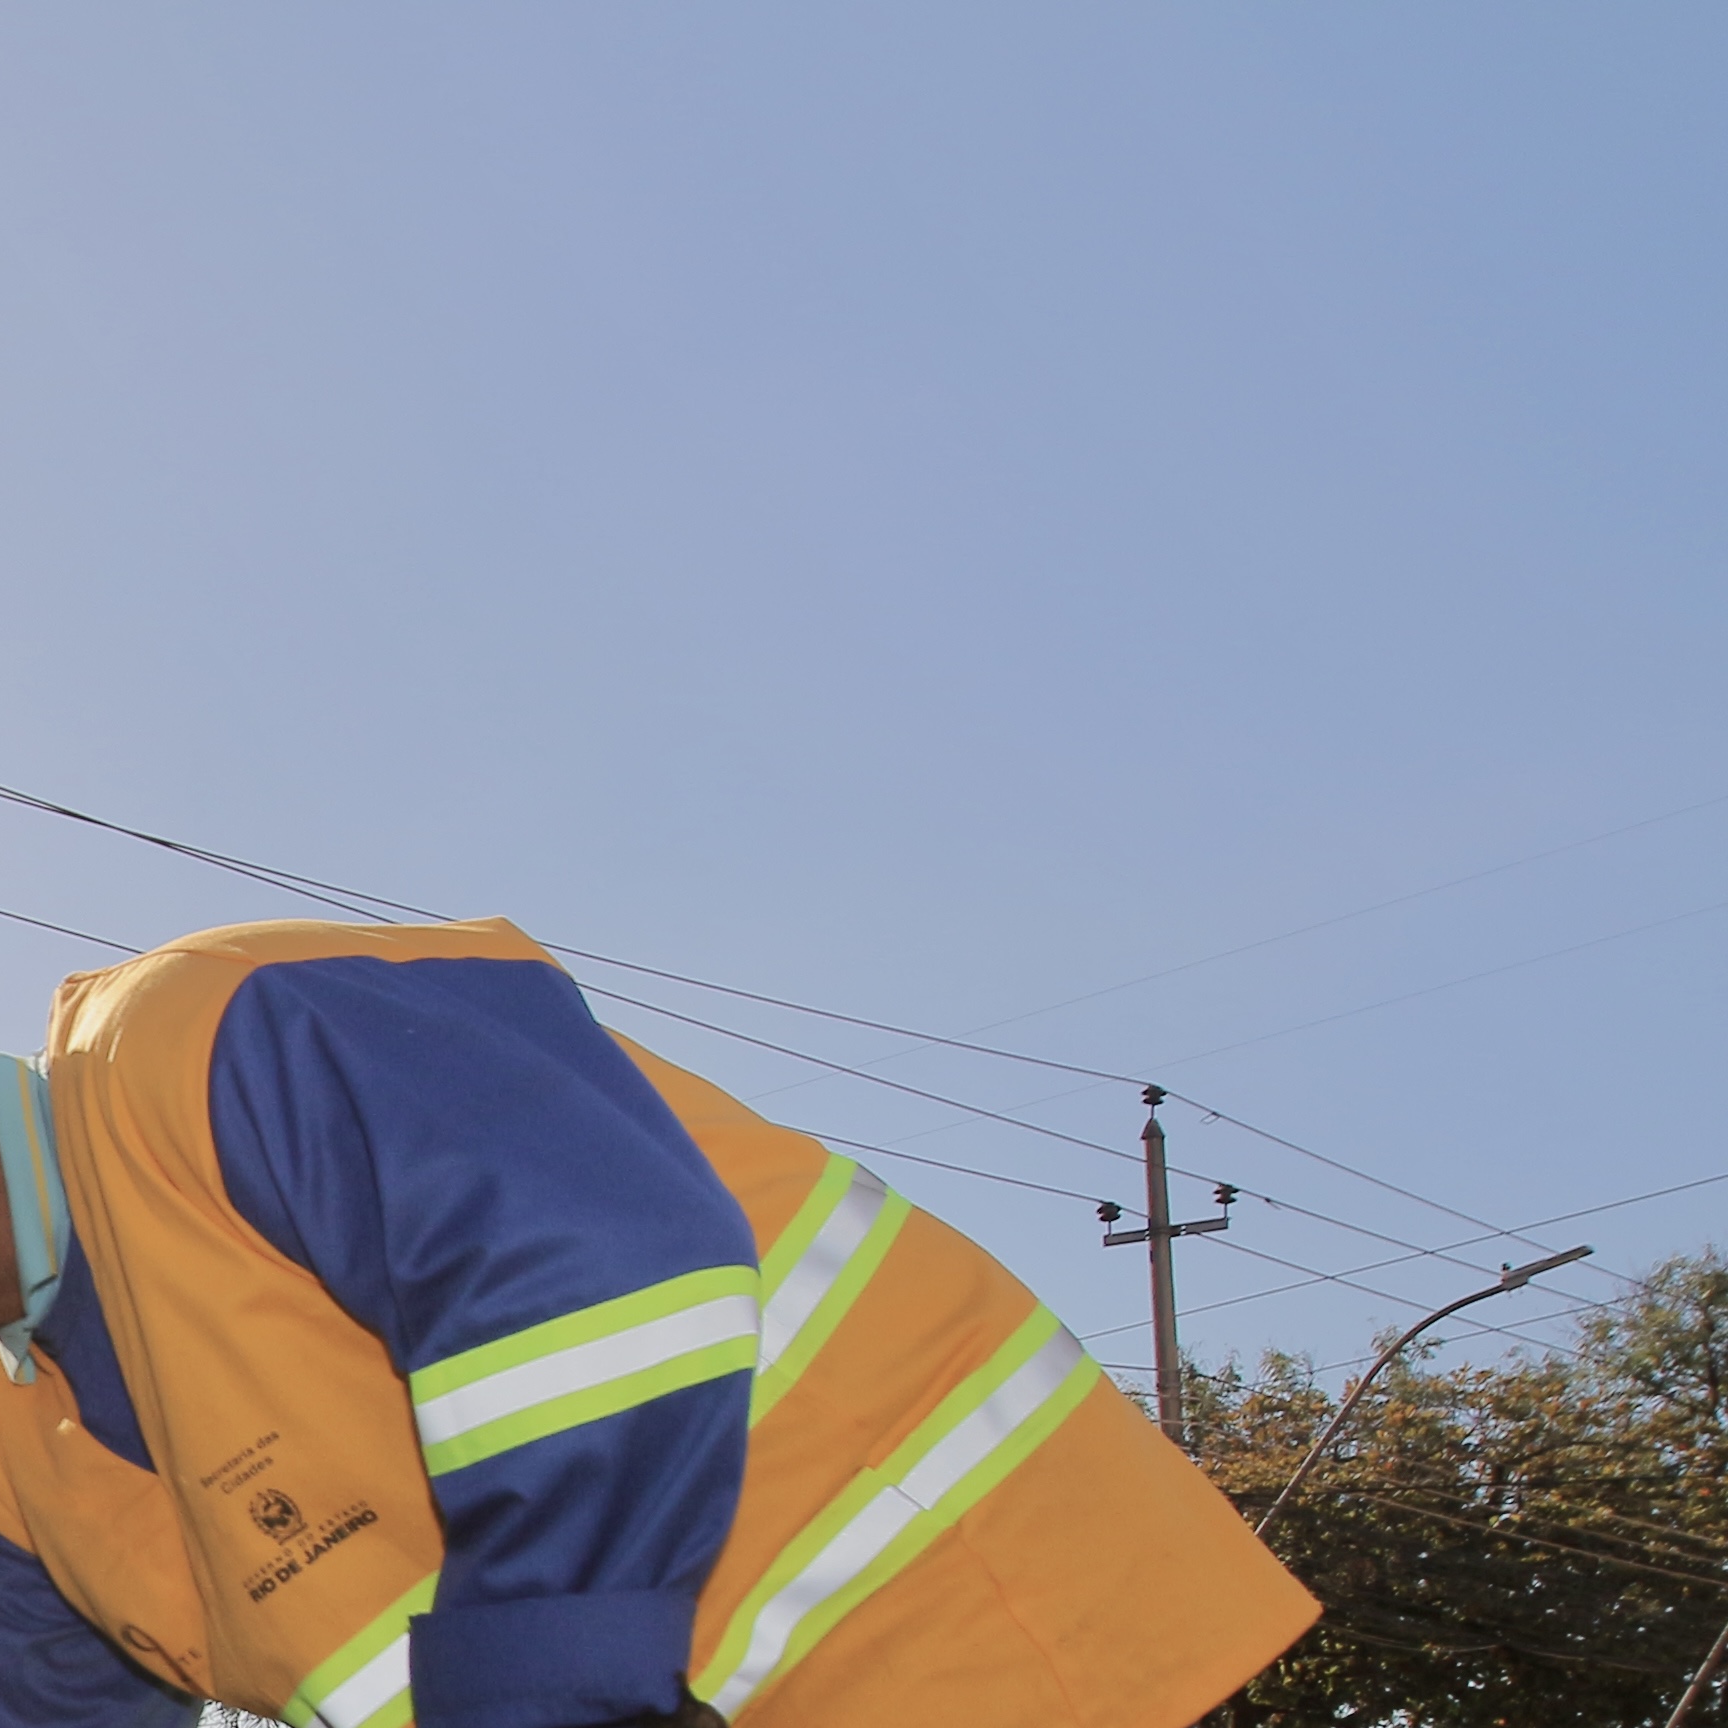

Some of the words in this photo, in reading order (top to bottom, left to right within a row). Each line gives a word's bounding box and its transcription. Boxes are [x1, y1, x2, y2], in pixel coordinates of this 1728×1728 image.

[249, 1578, 277, 1603] RIO
[275, 1558, 302, 1583] DE
[304, 1509, 378, 1565] JANEIRO
